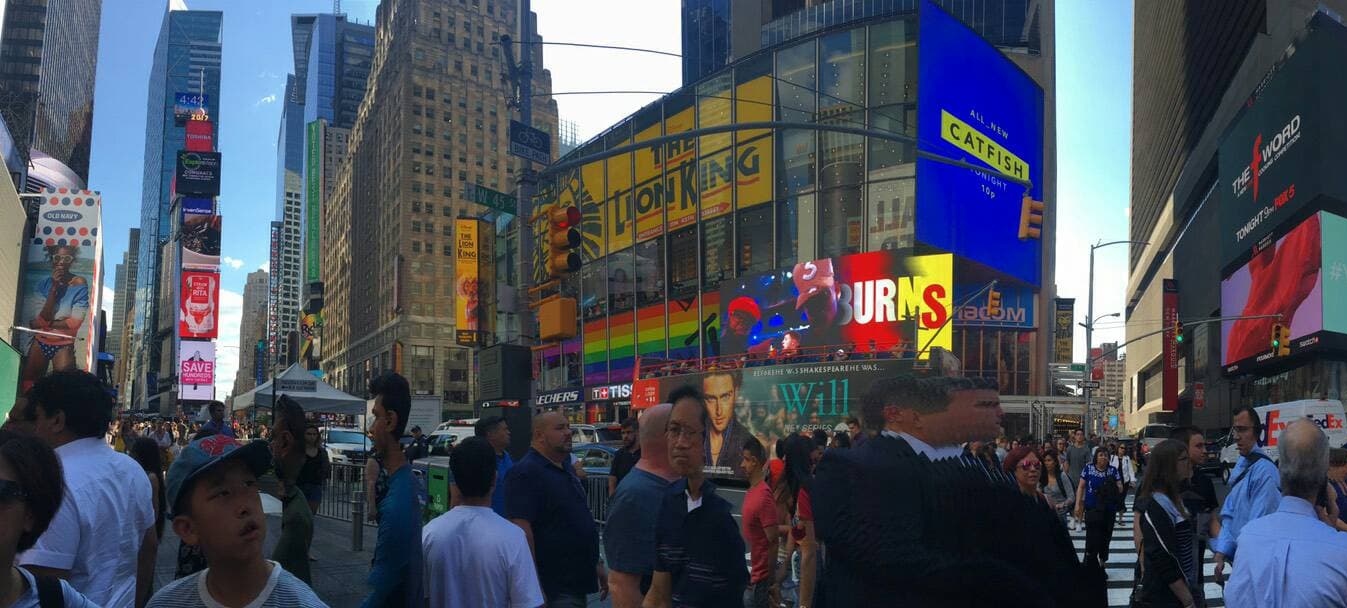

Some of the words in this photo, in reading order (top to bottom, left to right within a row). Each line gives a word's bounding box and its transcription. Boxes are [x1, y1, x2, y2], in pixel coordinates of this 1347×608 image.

[949, 122, 1023, 179] CATFISH
[1232, 165, 1251, 194] THE
[1250, 133, 1263, 204] f
[1262, 114, 1301, 162] WORD
[479, 188, 488, 203] W
[614, 174, 675, 236] LION
[680, 146, 760, 211] KING
[970, 168, 1007, 192] ONIGHT
[461, 233, 471, 241] THE
[1236, 212, 1265, 243] TONIGHT
[458, 248, 476, 260] KING
[838, 275, 947, 329] BURNS
[183, 362, 212, 373] SAVE
[779, 379, 849, 416] Will
